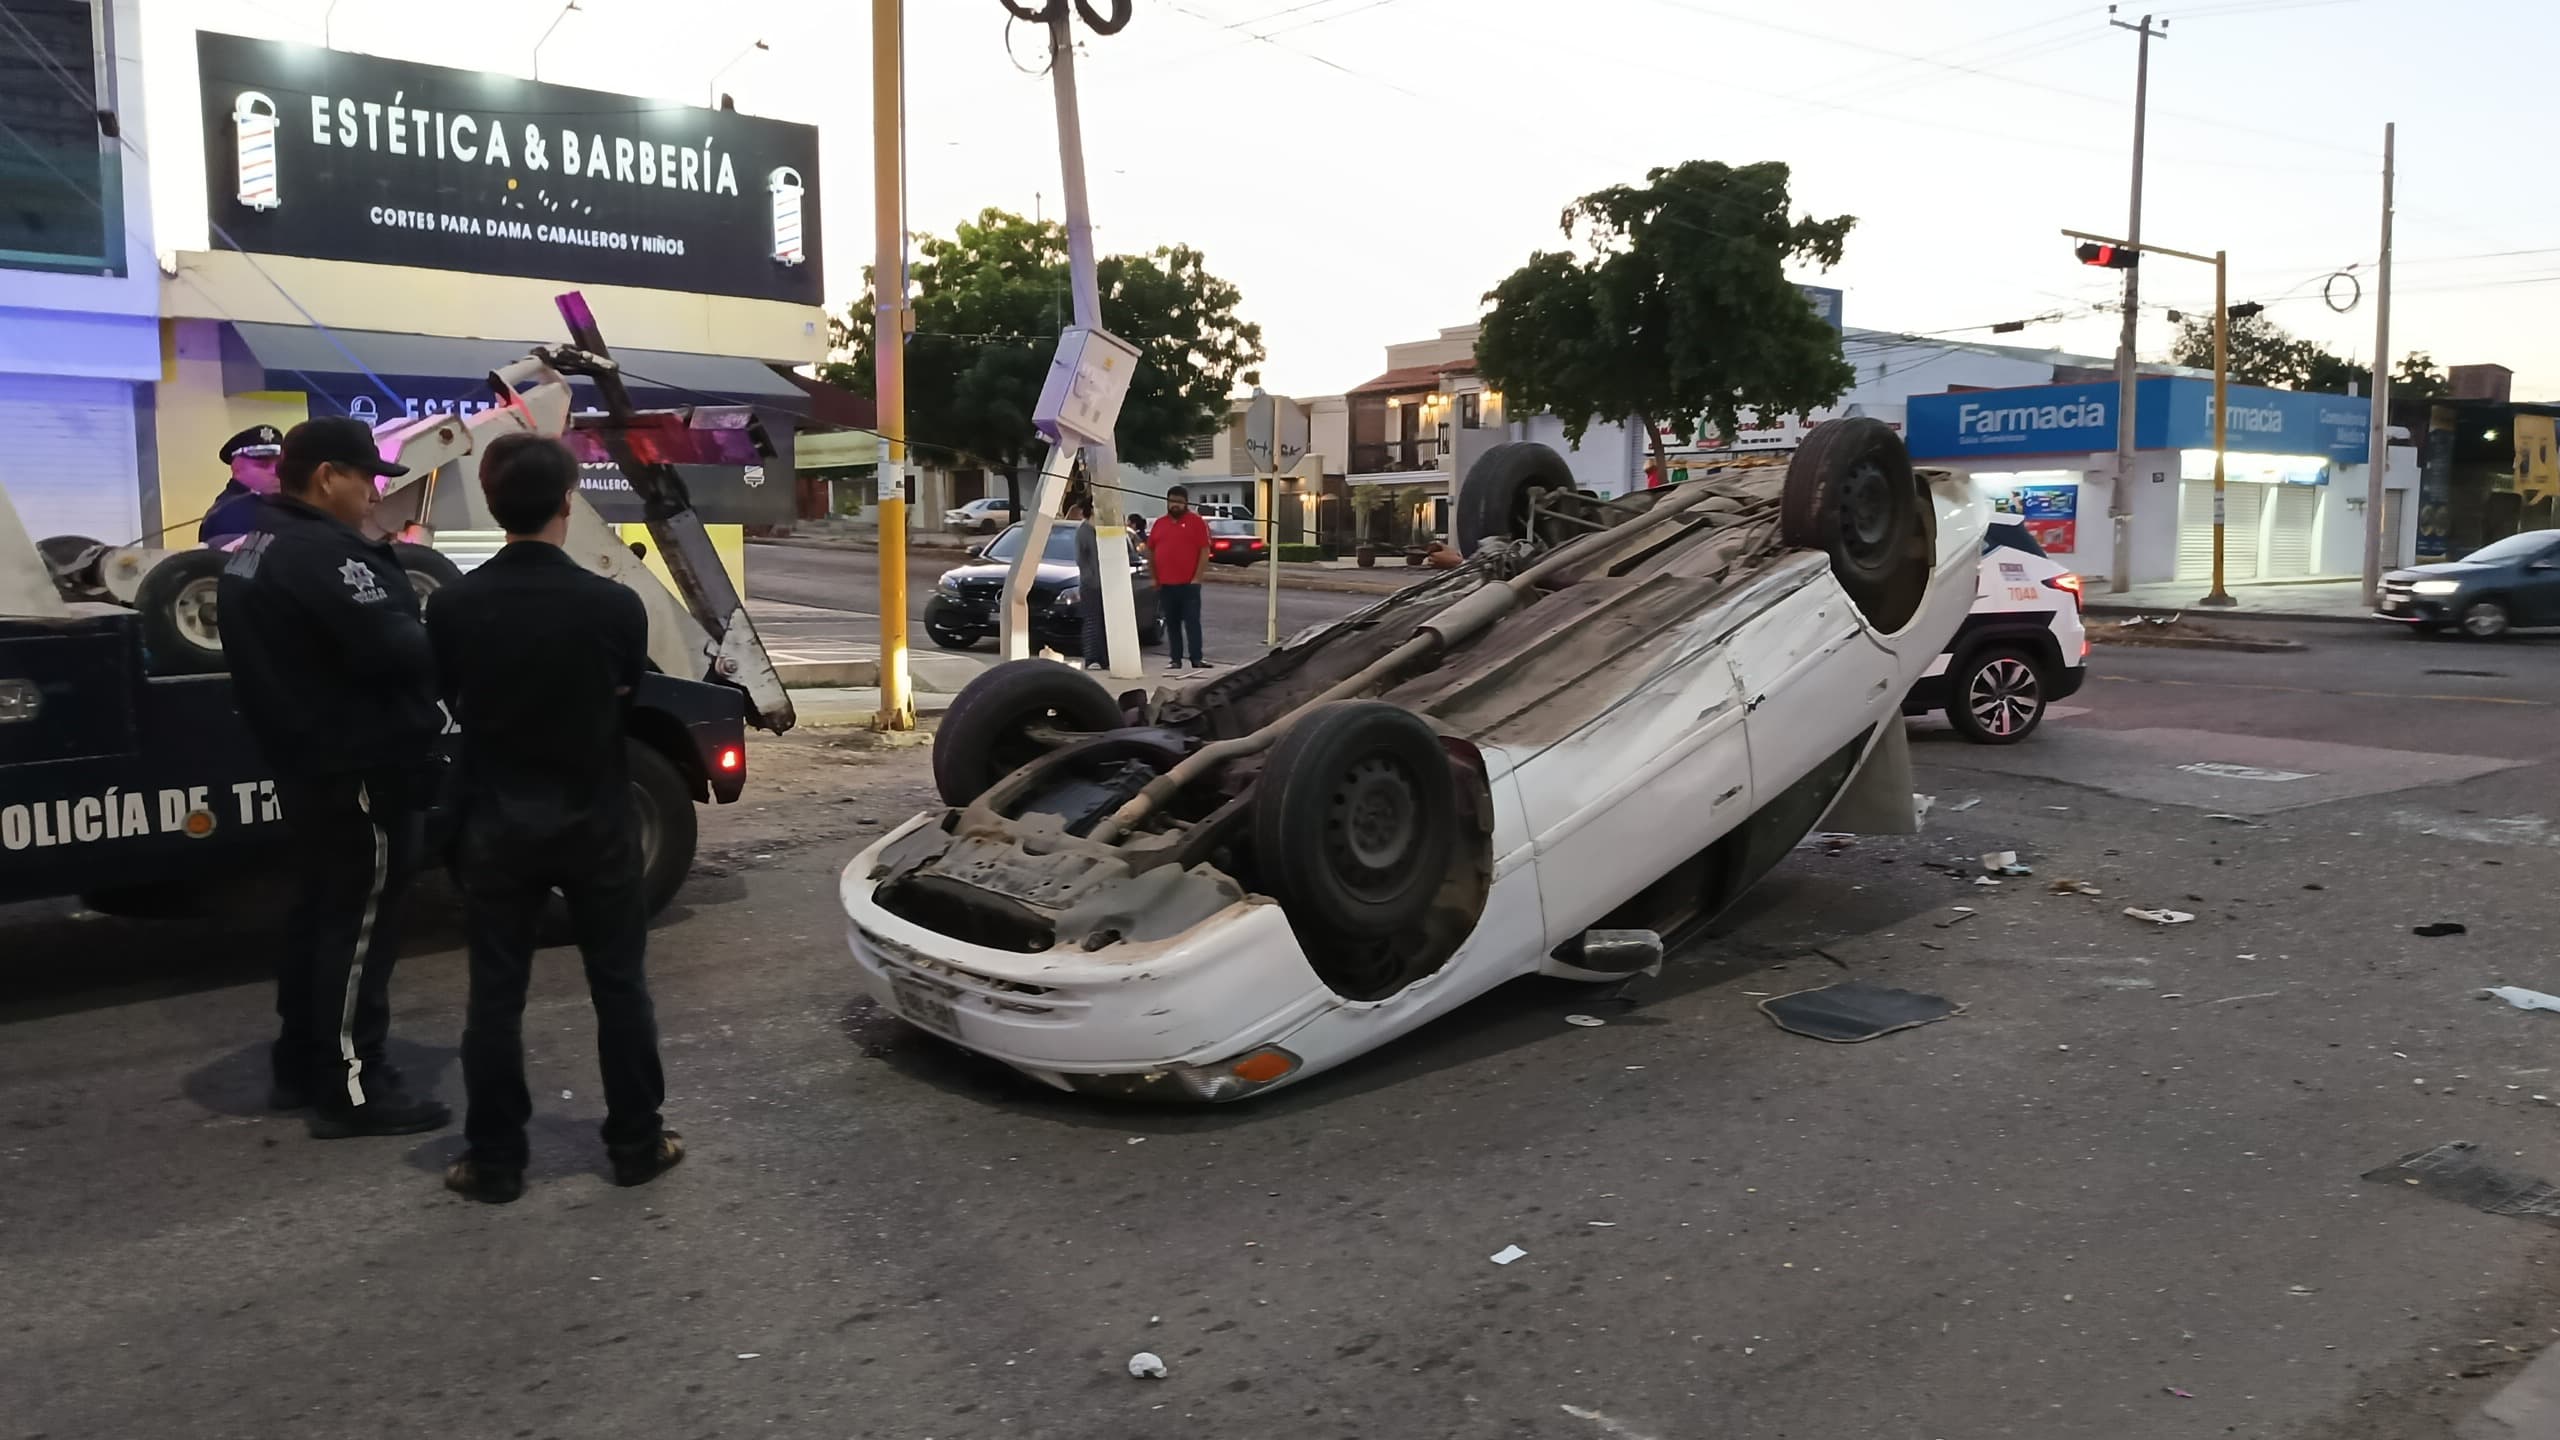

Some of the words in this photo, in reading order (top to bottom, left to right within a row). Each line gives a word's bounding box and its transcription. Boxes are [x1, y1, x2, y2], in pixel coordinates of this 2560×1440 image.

[311, 90, 511, 168] ESTÉTICA
[525, 123, 549, 171] &
[562, 129, 739, 197] BARBERÍA
[370, 206, 435, 231] CORTES
[440, 214, 481, 236] PARA
[486, 219, 533, 241] DAMA
[536, 224, 628, 250] CABALLEROS
[630, 233, 640, 251] Y
[642, 234, 685, 256] NIÑOS
[1958, 396, 2105, 434] Farmacia
[2205, 396, 2282, 432] Frmacia
[579, 478, 634, 491] ABALLERO
